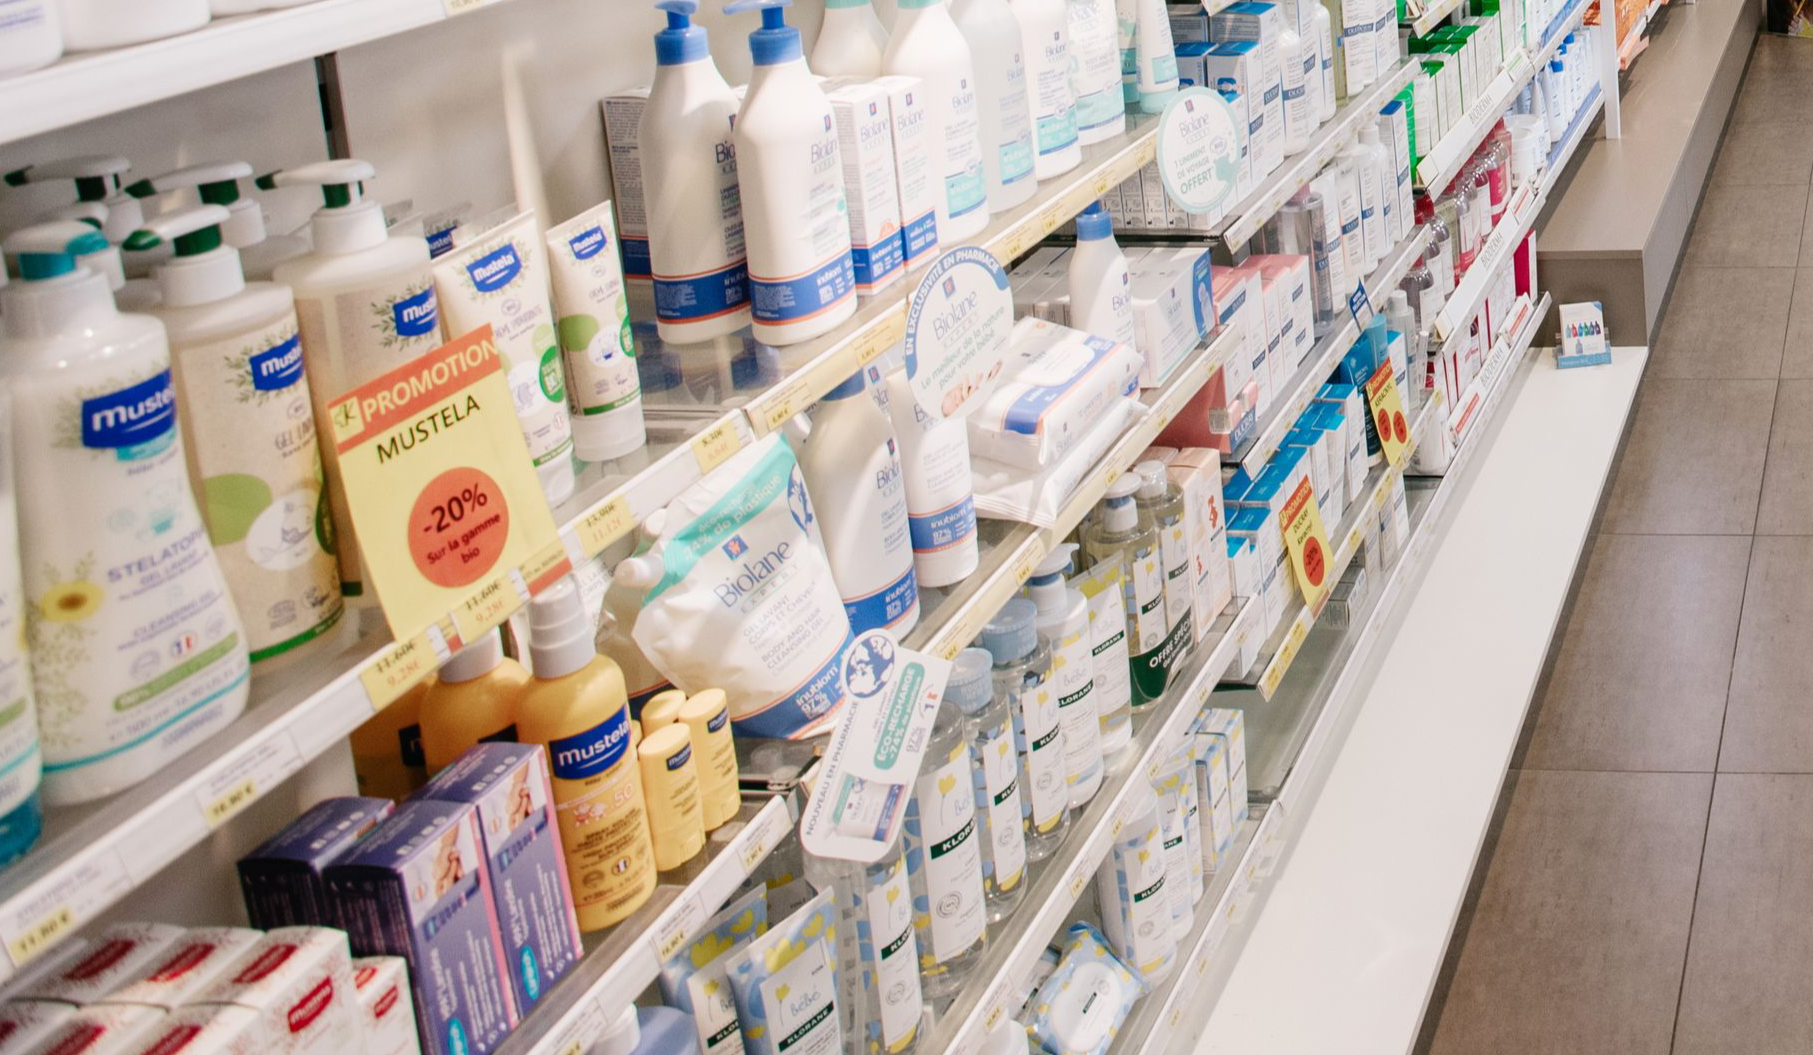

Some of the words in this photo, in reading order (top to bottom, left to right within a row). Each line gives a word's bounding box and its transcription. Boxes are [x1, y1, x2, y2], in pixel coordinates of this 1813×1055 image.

[1180, 113, 1209, 133] Biolane
[1180, 169, 1213, 196] OFFERT
[944, 254, 955, 268] EN
[954, 250, 1000, 273] PHARMACIE
[906, 265, 944, 340] EXCLUSIVITÉ
[933, 291, 977, 337] Biolane
[907, 340, 914, 354] EN
[362, 338, 495, 422] PROMOTION
[376, 396, 480, 464] MUSTELA
[423, 484, 488, 534] -20%
[427, 547, 446, 565] Sur
[449, 535, 461, 550] la
[462, 514, 501, 546] gamme
[461, 546, 480, 564] bio
[714, 542, 793, 607] Biolane
[787, 623, 803, 642] AND
[1150, 643, 1172, 669] OFFRE
[806, 781, 830, 835] NOUVEAU
[828, 767, 836, 780] EN
[835, 701, 859, 766] PHARMACIE
[787, 1004, 832, 1045] KLORANE
